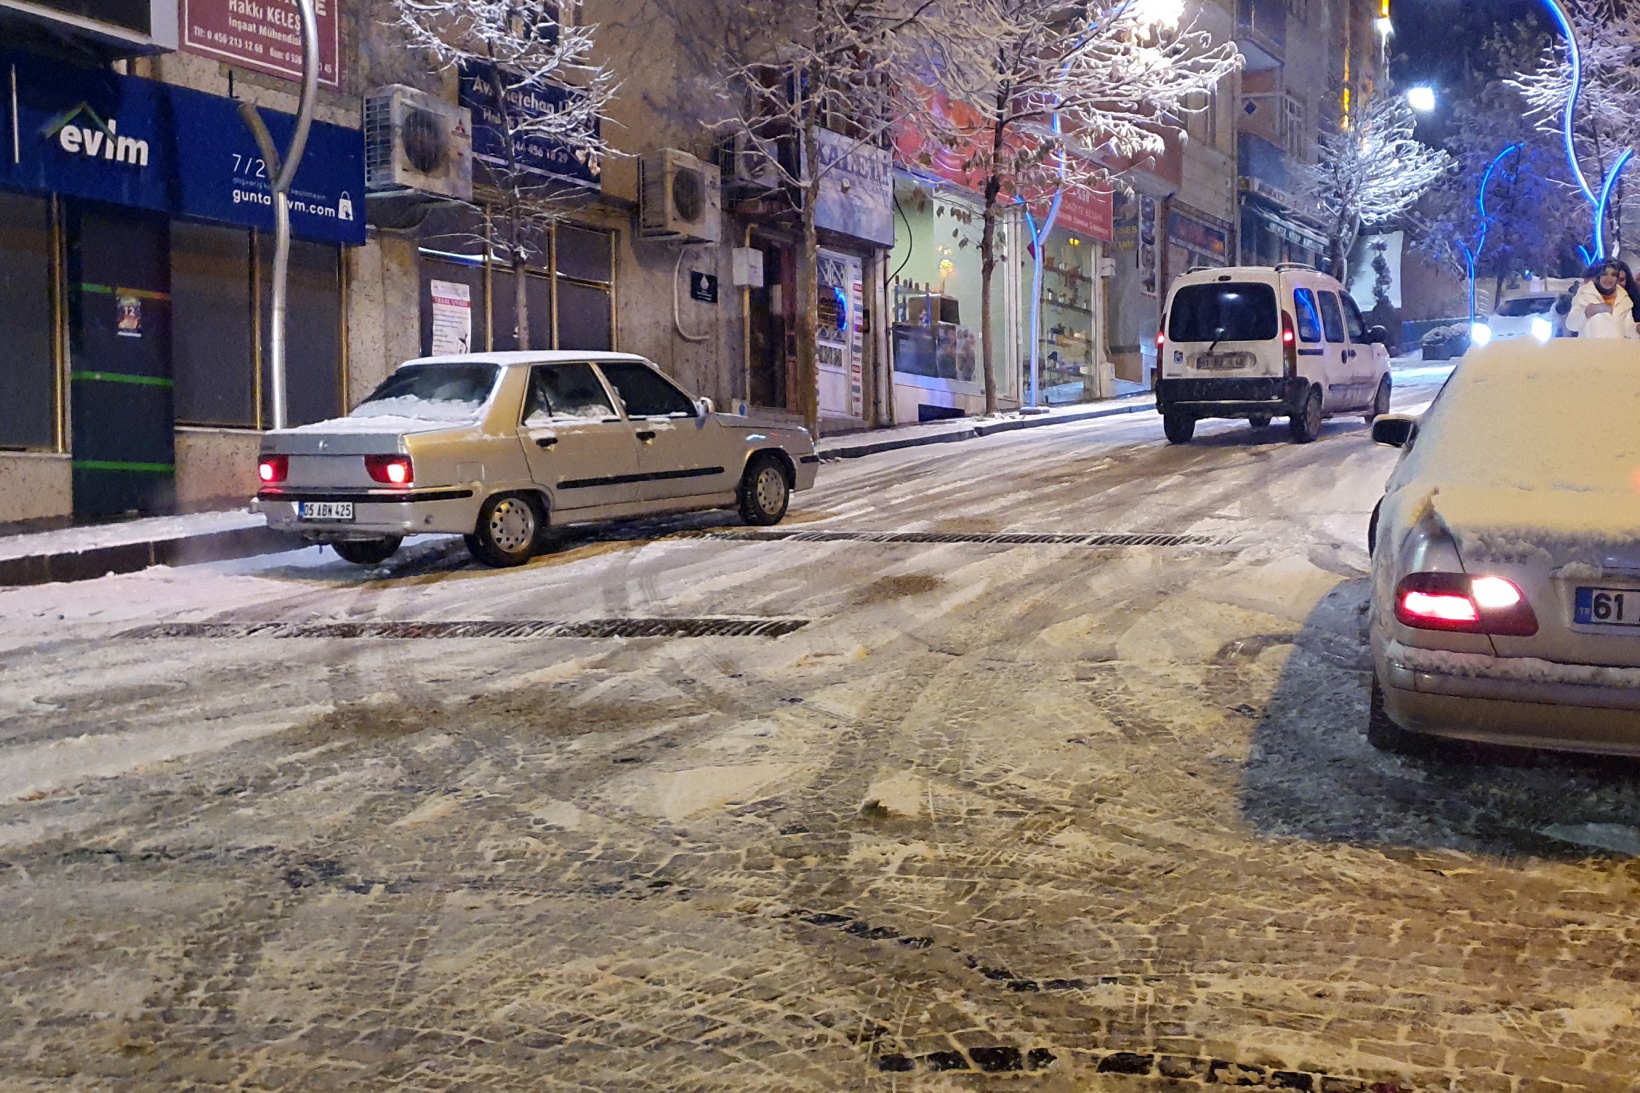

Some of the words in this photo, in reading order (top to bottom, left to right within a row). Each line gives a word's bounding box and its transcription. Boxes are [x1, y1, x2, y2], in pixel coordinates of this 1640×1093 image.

[267, 6, 301, 35] KELEŞ
[229, 36, 243, 48] 213
[245, 40, 253, 51] 12
[472, 75, 494, 97] Av.
[507, 91, 555, 114] etehan
[60, 118, 149, 167] evim
[232, 189, 336, 218] guntavm.com
[124, 306, 136, 317] 12
[335, 504, 351, 516] 425
[1593, 592, 1624, 621] 61
